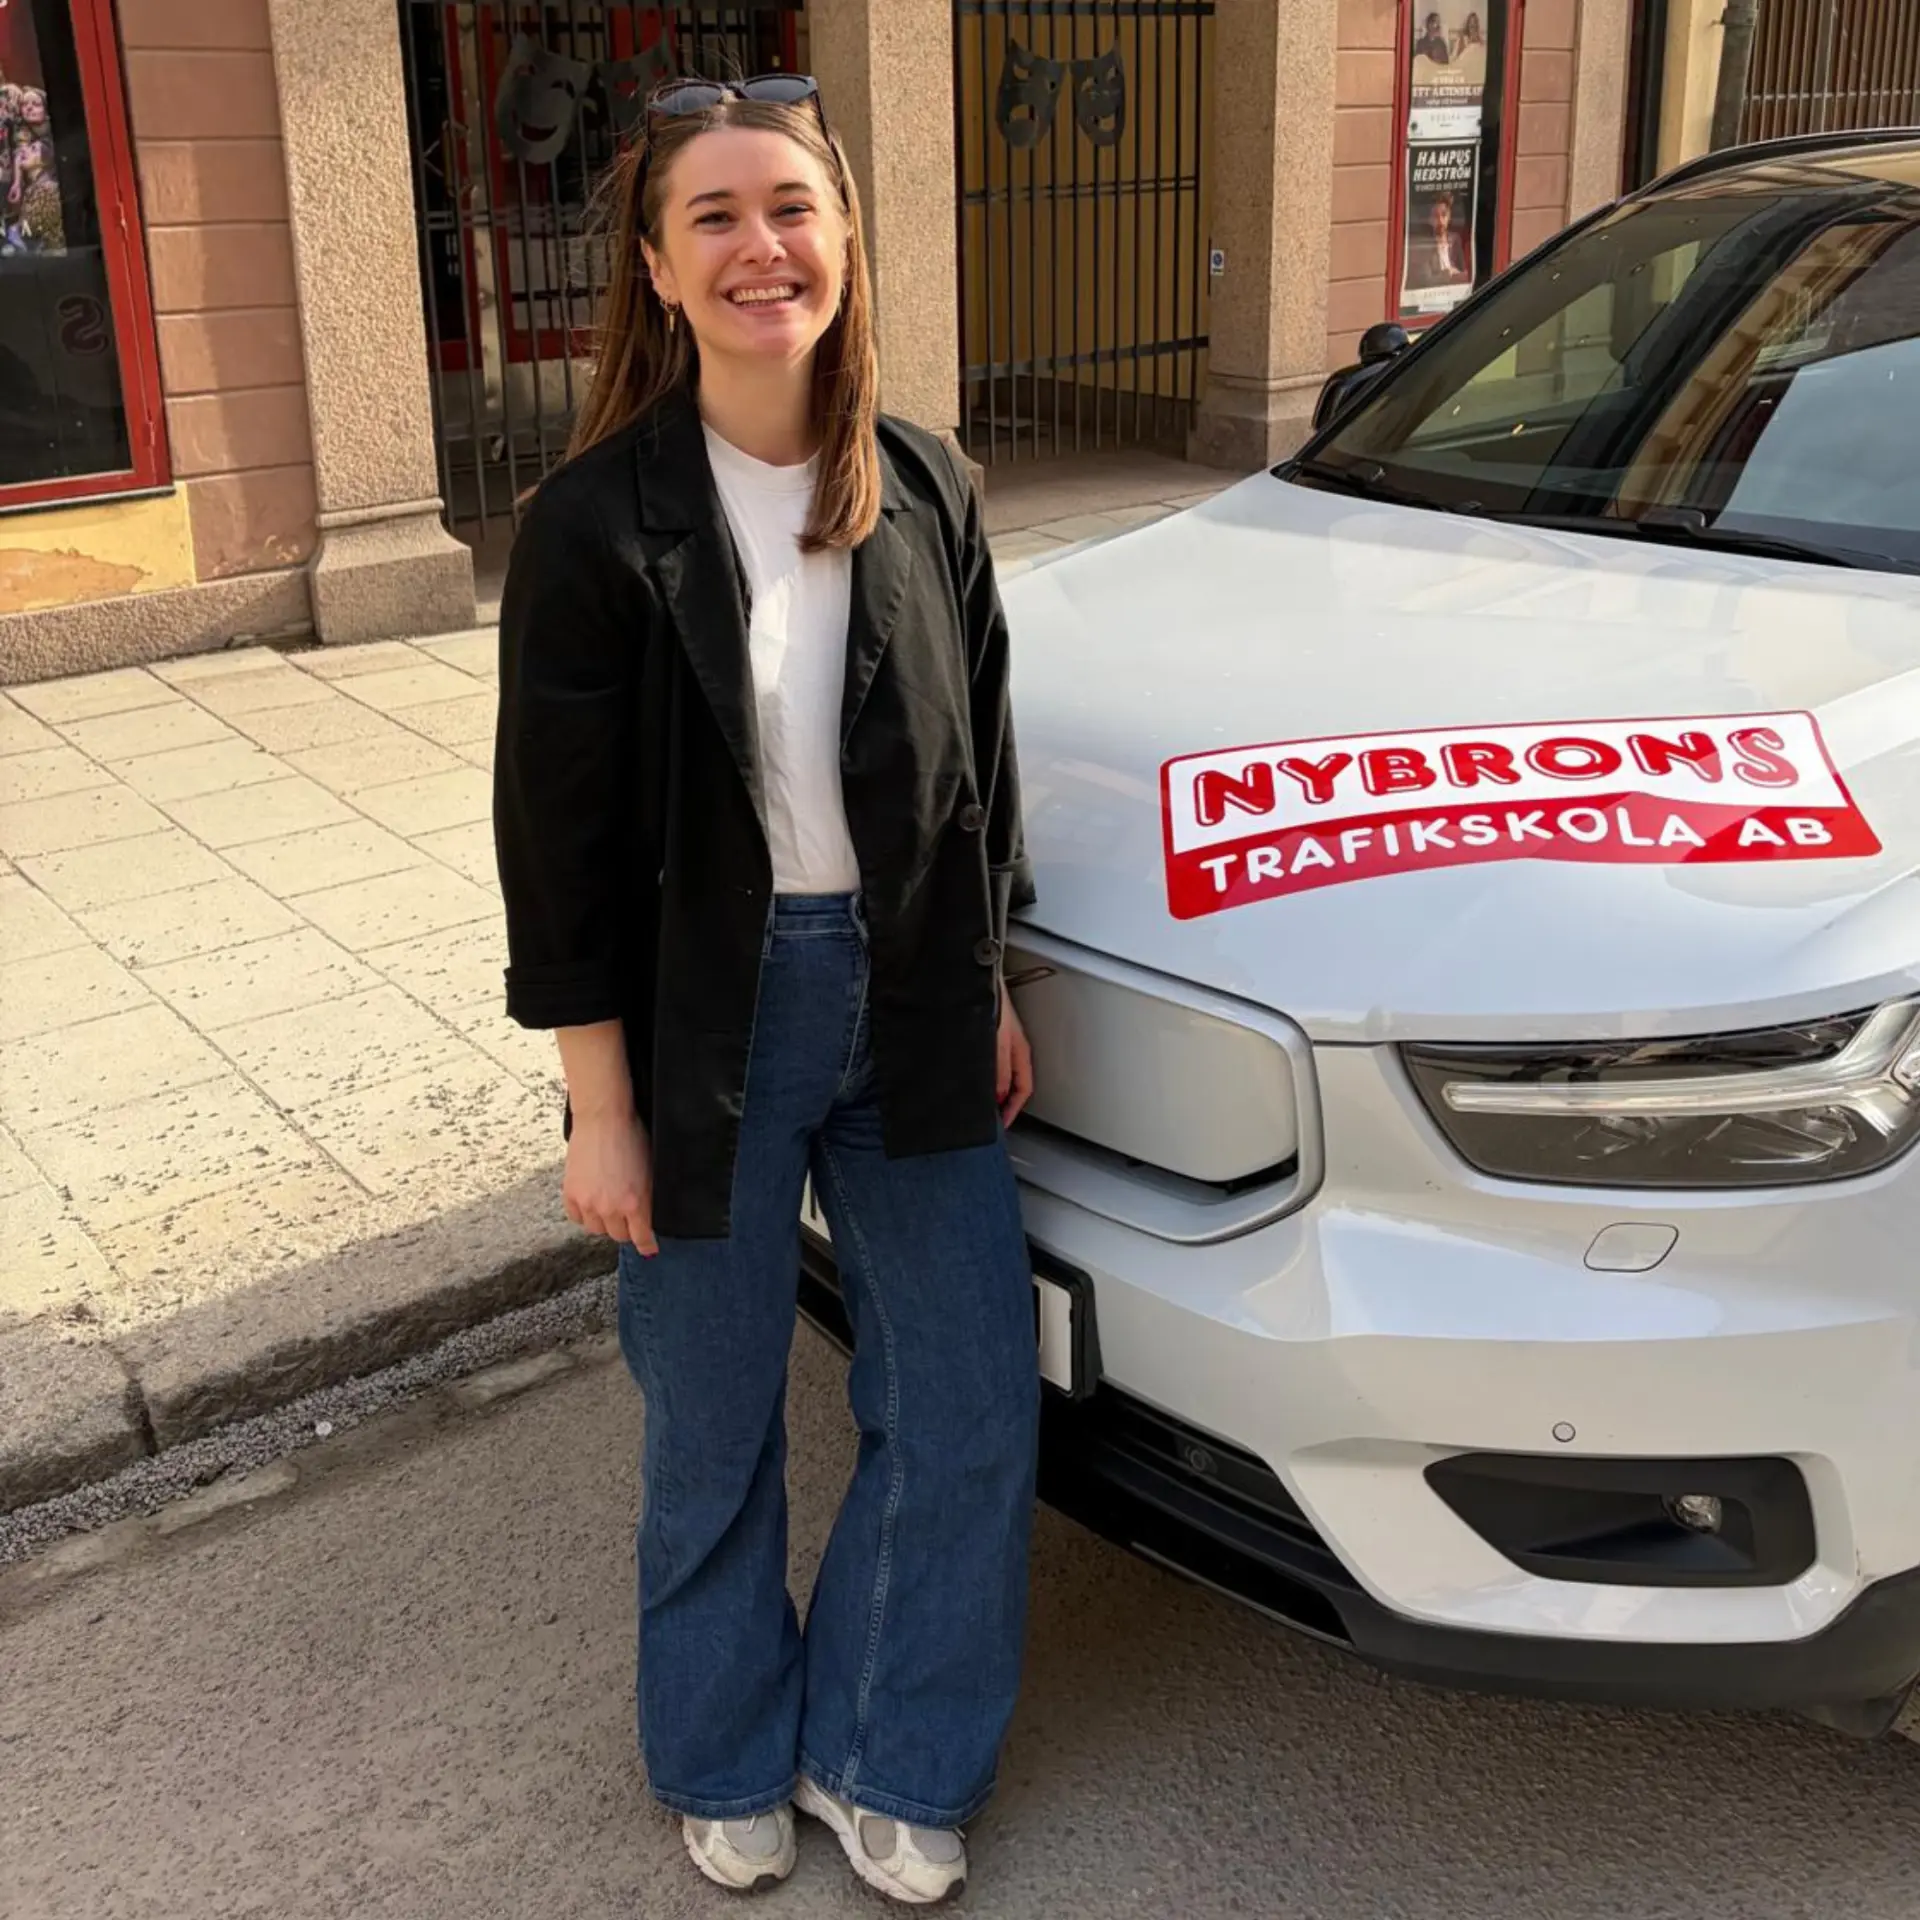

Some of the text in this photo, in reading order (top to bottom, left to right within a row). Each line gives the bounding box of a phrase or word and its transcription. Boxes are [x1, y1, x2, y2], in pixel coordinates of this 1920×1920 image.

[1413, 165, 1471, 181] HEDSTRÖM
[1416, 149, 1471, 166] HAMPUS
[1193, 727, 1799, 826] NYBRONS
[1199, 806, 1833, 893] TRAFIKSKOLA AB
